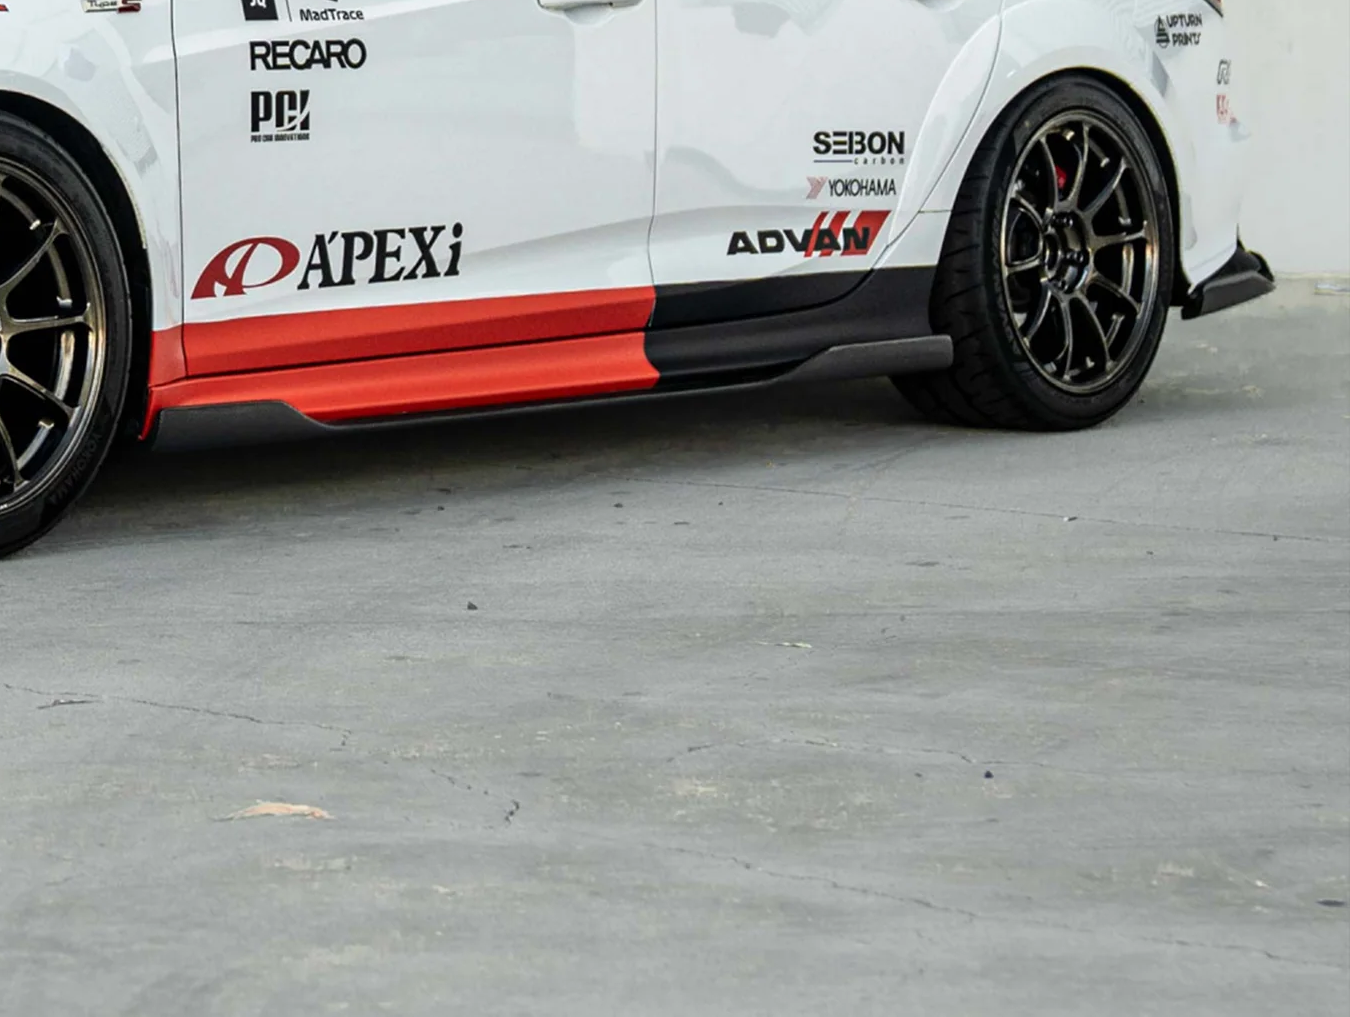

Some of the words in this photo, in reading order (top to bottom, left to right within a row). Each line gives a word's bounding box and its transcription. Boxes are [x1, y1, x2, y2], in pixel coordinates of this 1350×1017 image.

[299, 8, 364, 22] MadTrace
[1166, 13, 1203, 28] UPTURN
[1171, 31, 1202, 47] PRINTS
[249, 38, 368, 71] RECARO
[250, 89, 310, 133] PCI
[853, 156, 905, 166] carbon
[828, 178, 897, 197] YOKOHAMA
[726, 227, 871, 256] ADVAN
